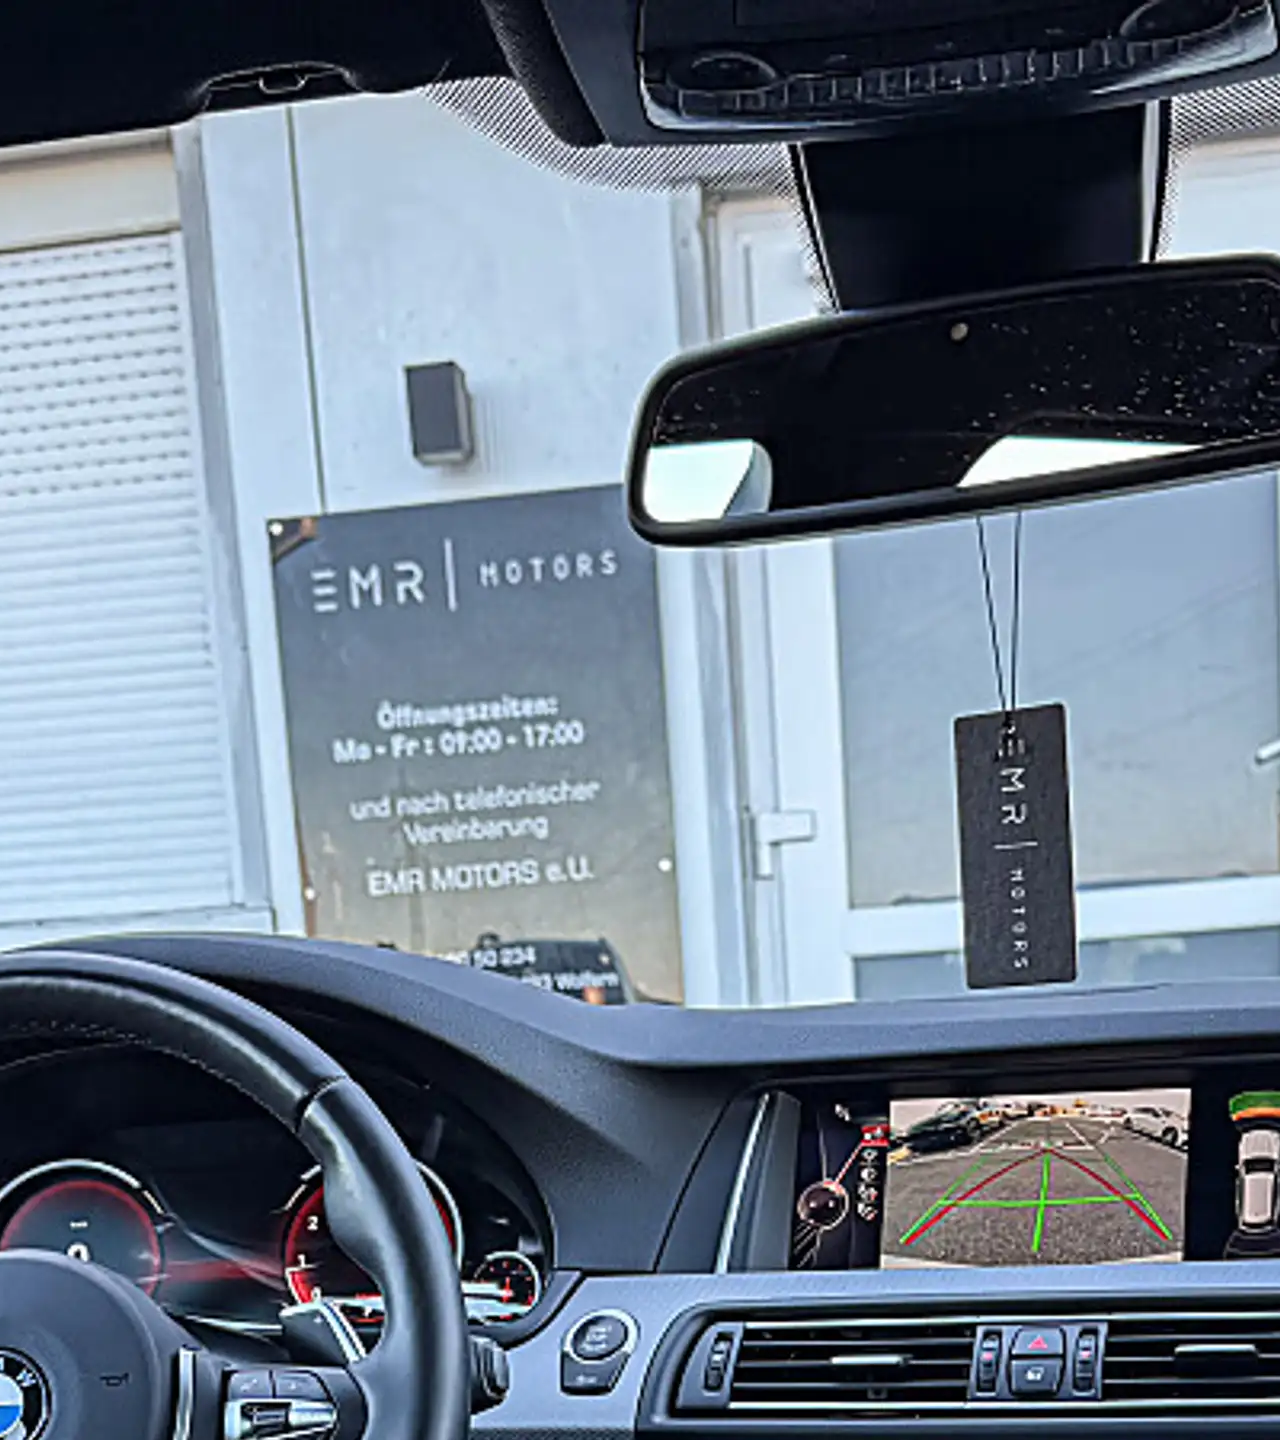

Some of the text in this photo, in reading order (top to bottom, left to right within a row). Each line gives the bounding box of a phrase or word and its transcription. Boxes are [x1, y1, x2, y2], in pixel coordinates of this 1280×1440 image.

[309, 548, 619, 614] EMR MOTORS
[521, 719, 586, 749] 17:00
[349, 779, 601, 821] und nach telefonischer
[366, 862, 426, 897] EMR
[429, 857, 541, 892] MOTORS
[1010, 868, 1030, 969] MOTORS
